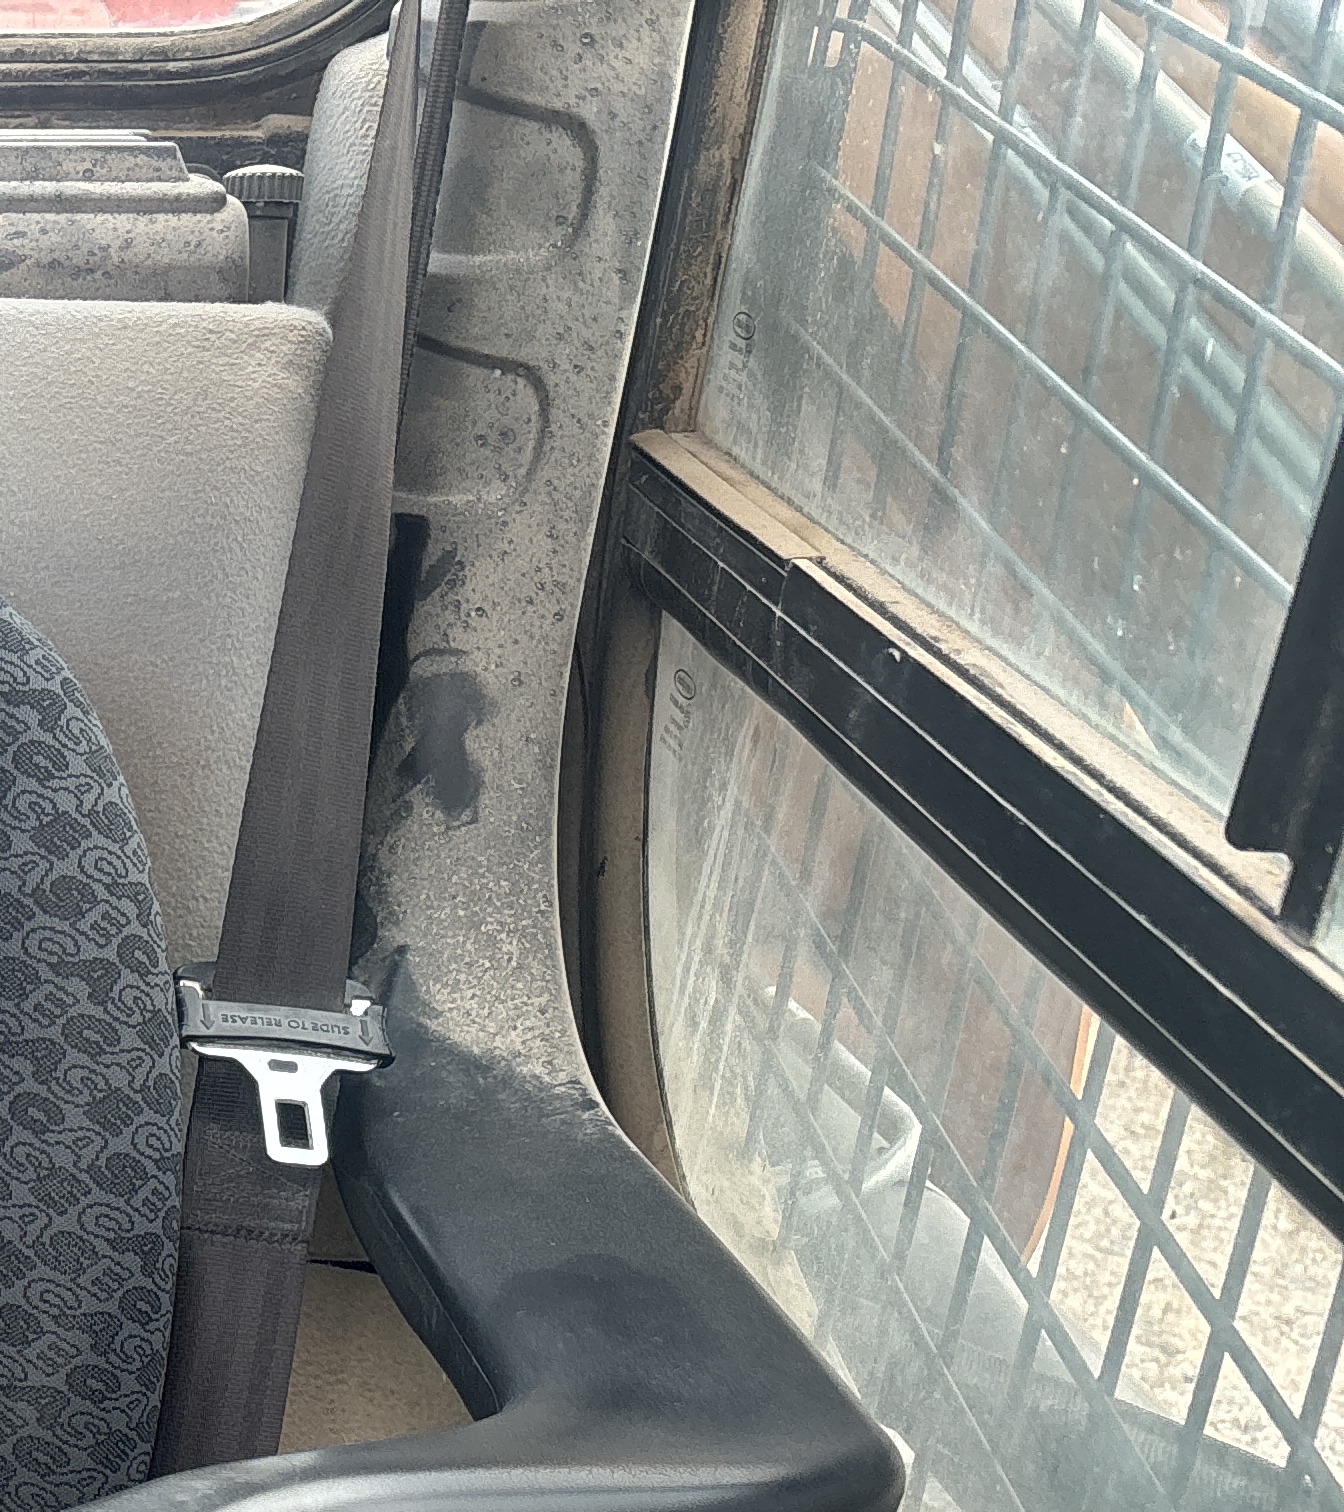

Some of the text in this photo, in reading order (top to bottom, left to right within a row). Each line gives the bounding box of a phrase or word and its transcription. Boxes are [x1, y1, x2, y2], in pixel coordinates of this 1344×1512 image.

[220, 1013, 351, 1036] SLIDE TO RELEASE
